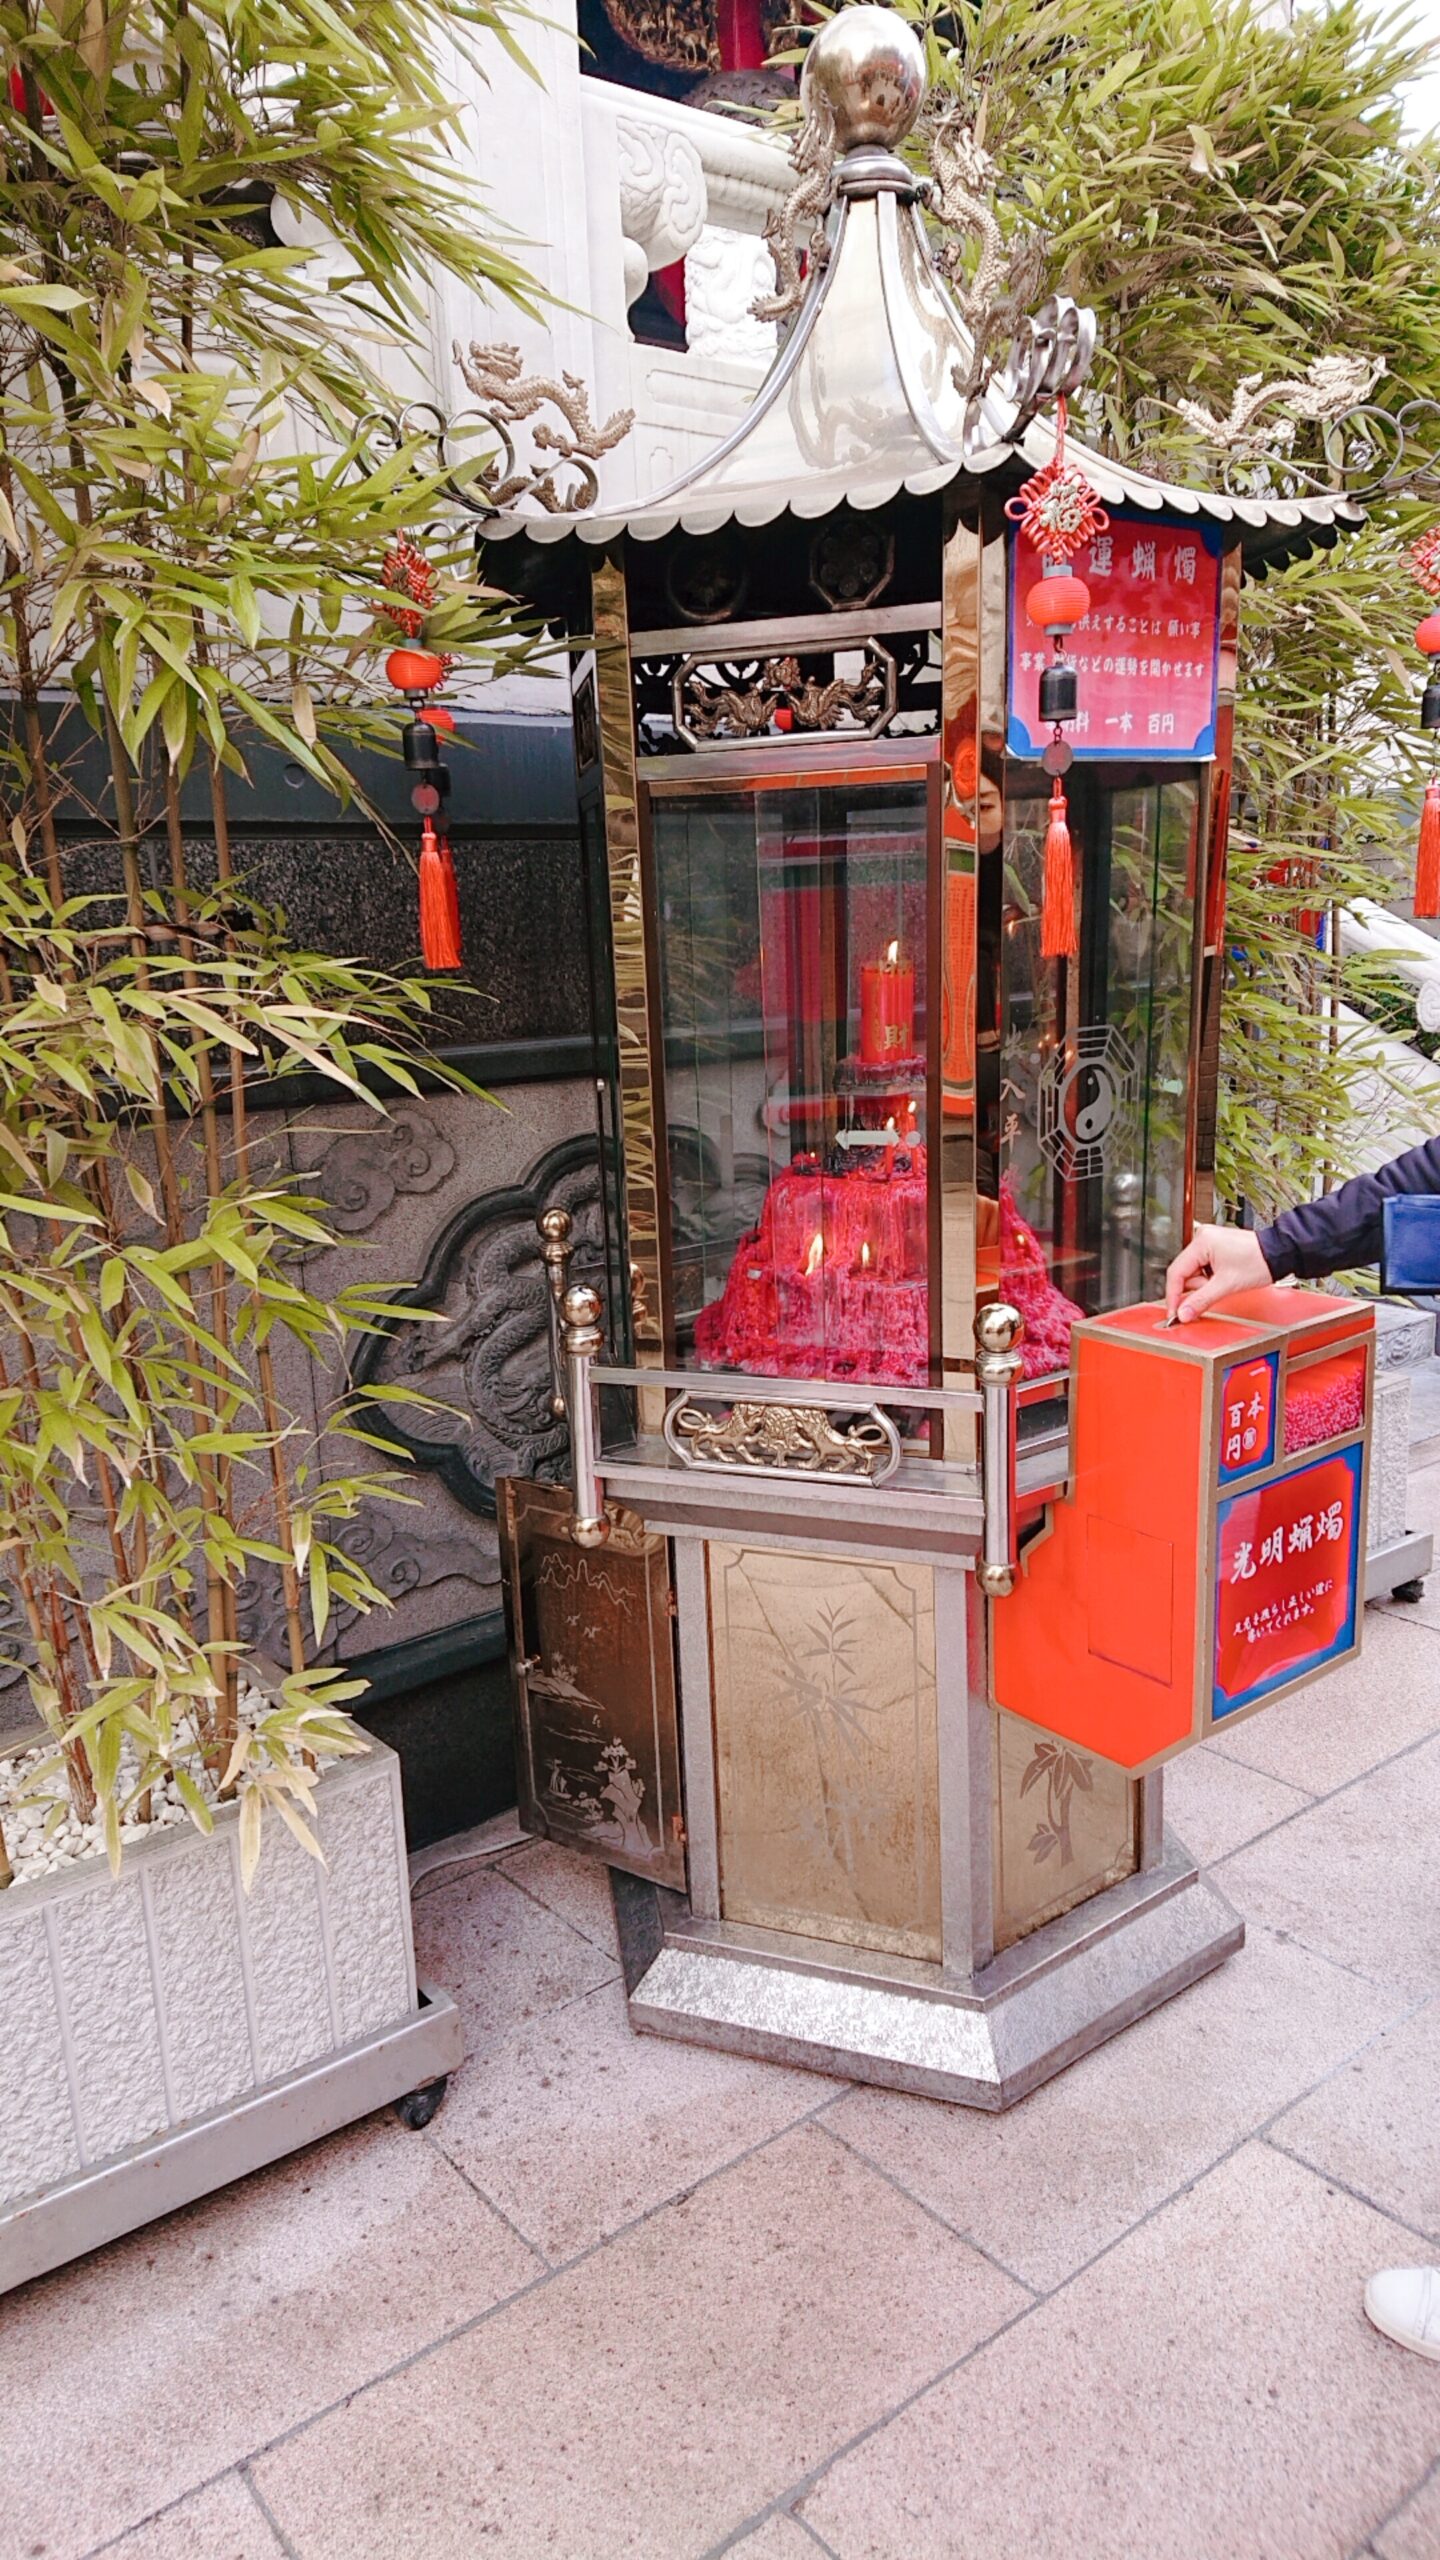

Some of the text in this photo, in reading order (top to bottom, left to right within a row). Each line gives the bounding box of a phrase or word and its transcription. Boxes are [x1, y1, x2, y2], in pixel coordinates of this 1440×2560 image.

[1043, 534, 1197, 585] 運蝋燭
[1104, 711, 1134, 734] 一本
[1147, 712, 1175, 735] 百円
